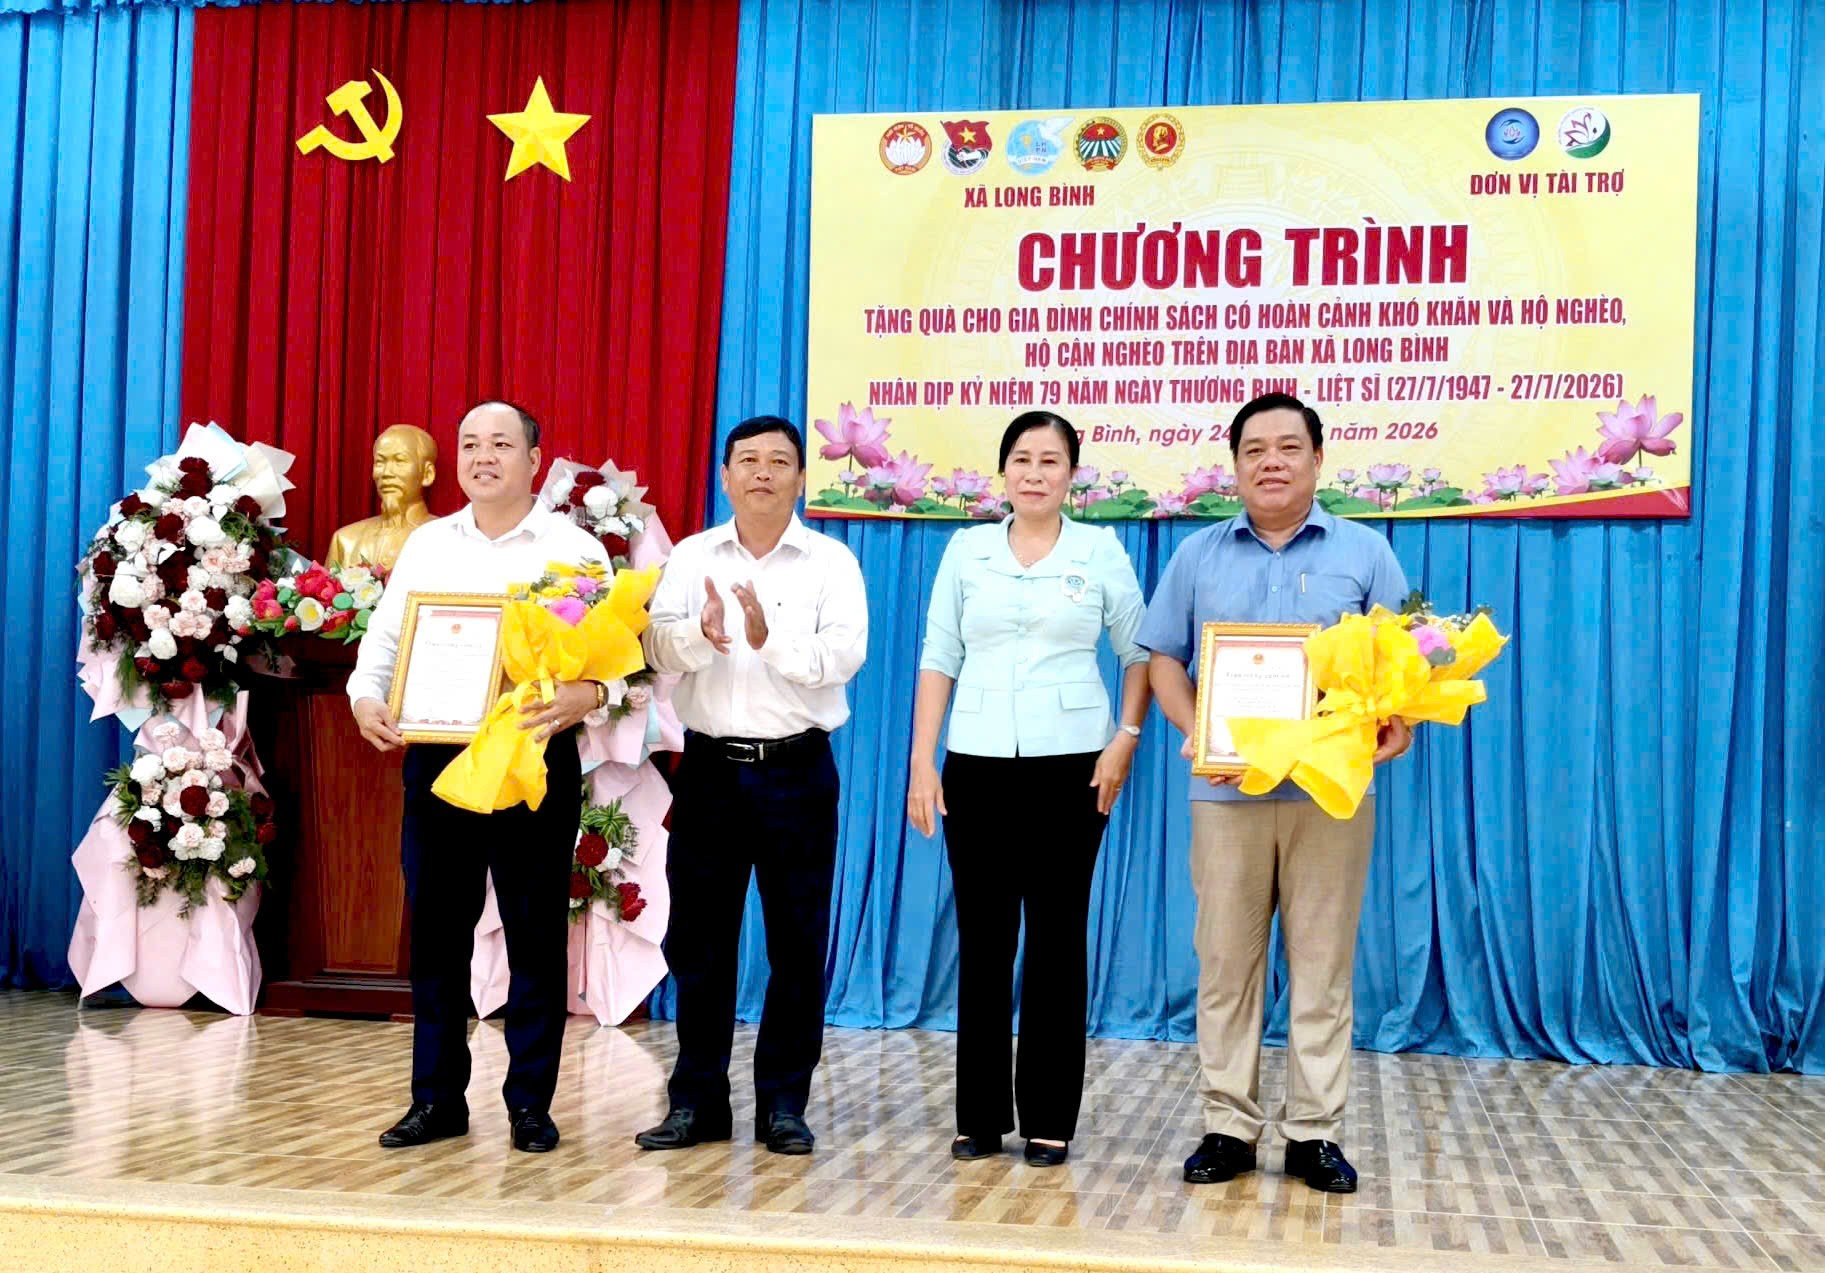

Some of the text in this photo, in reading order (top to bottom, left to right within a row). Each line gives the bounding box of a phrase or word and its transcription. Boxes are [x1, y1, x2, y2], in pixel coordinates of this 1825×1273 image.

[964, 183, 1095, 208] XÃ LONG BÌNH
[1470, 168, 1625, 198] ĐƠN VỊ TÀI TRỢ
[1018, 216, 1469, 292] CHƯƠNG TRÌNH
[864, 294, 1627, 339] TẶNG QUÀ CHO GIA ĐÌNH CHÍNH SÁCH CÓ HOÀN CẢNH KHÓ KHĂN VÀ HỘ NGHÈO,
[1025, 333, 1449, 371] HỘ CẬN NGHÈO TRÊN ĐỊA BÀN XÃ LONG BÌNH
[869, 377, 917, 405] NHÂN
[923, 382, 954, 410] DỊP
[960, 376, 983, 405] KỶ
[989, 377, 1033, 409] NIỆM
[1040, 381, 1061, 405] 79
[1067, 377, 1108, 405] NĂM
[1114, 376, 1163, 404] NGÀY
[1169, 376, 1245, 404] THƯƠNG
[1317, 373, 1354, 407] LIỆT
[1361, 374, 1380, 402] SĨ
[1387, 375, 1491, 401] (27/7/1947
[1511, 374, 1623, 400] 27/7/2026)
[1091, 423, 1141, 446] Bình,
[1149, 424, 1203, 447] ngày
[1330, 422, 1378, 441] năm
[1385, 421, 1439, 440] 2026
